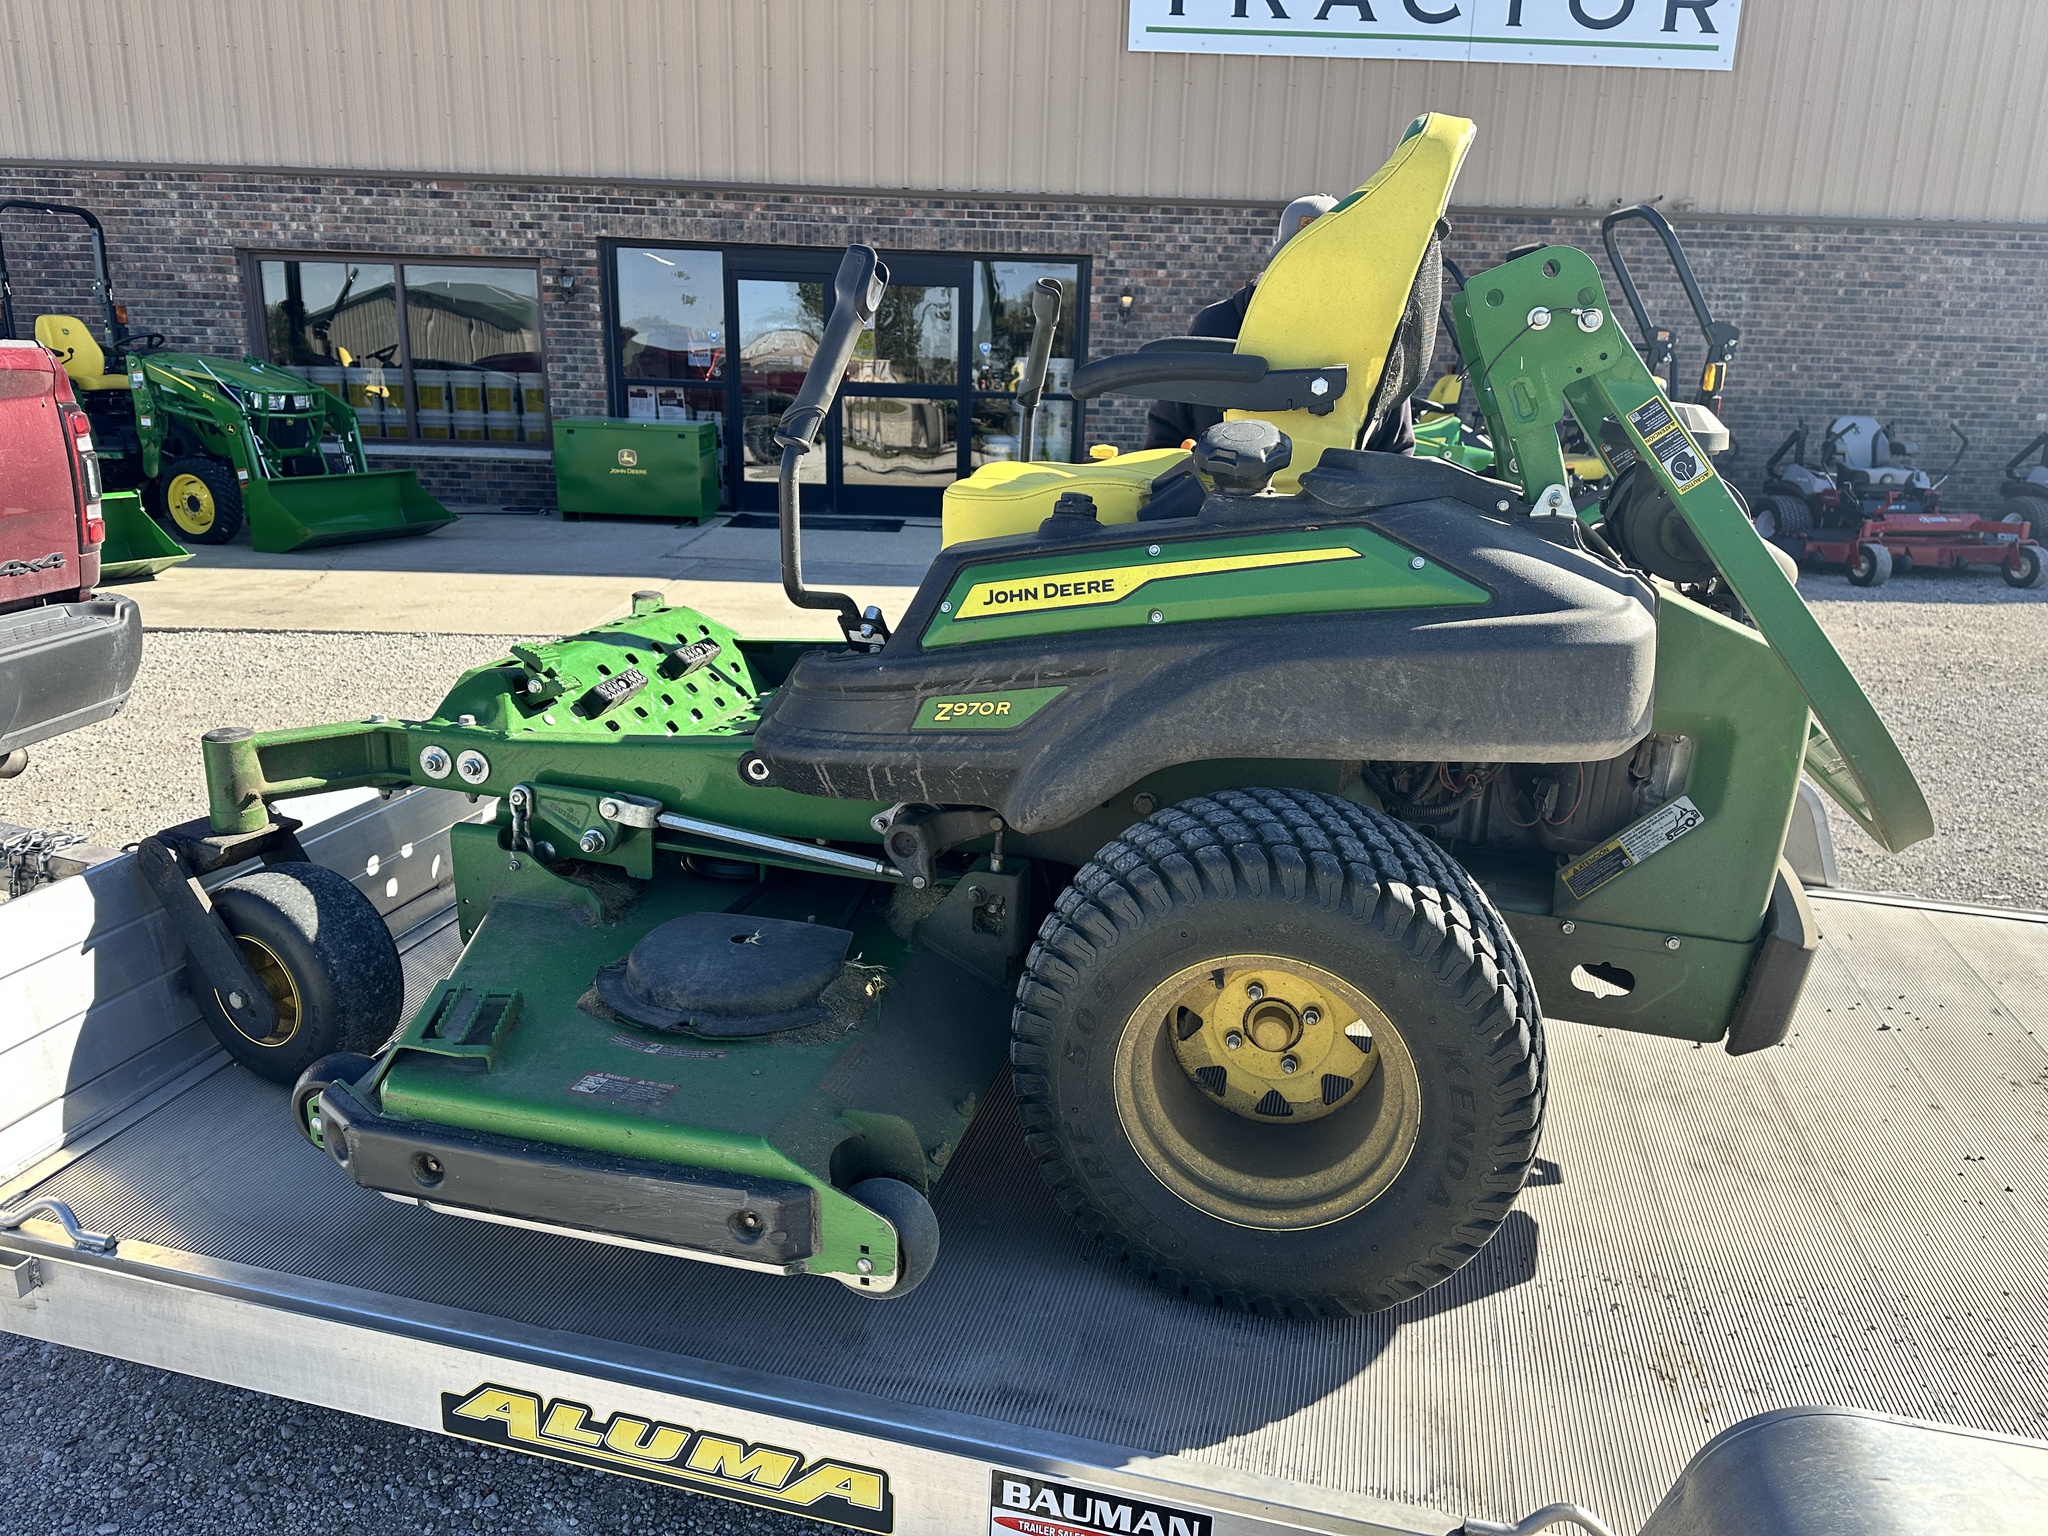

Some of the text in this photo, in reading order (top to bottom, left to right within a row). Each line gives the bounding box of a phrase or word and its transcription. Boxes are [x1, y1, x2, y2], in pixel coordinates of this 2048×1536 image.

[1644, 422, 1673, 445] ATENCIÓN
[609, 467, 626, 475] JOHN
[1680, 474, 1706, 493] CAUTION
[983, 578, 1115, 606] JOHN DEERE
[933, 701, 1012, 722] Z970R
[1577, 846, 1610, 870] ATENCIÓN
[1063, 973, 1117, 1070] 505
[604, 1072, 631, 1082] DANGER
[1424, 1044, 1478, 1209] KENDA
[452, 1387, 883, 1512] ALUMA
[1002, 1479, 1201, 1536] BAUMAN
[1018, 1520, 1056, 1536] TRAILER
